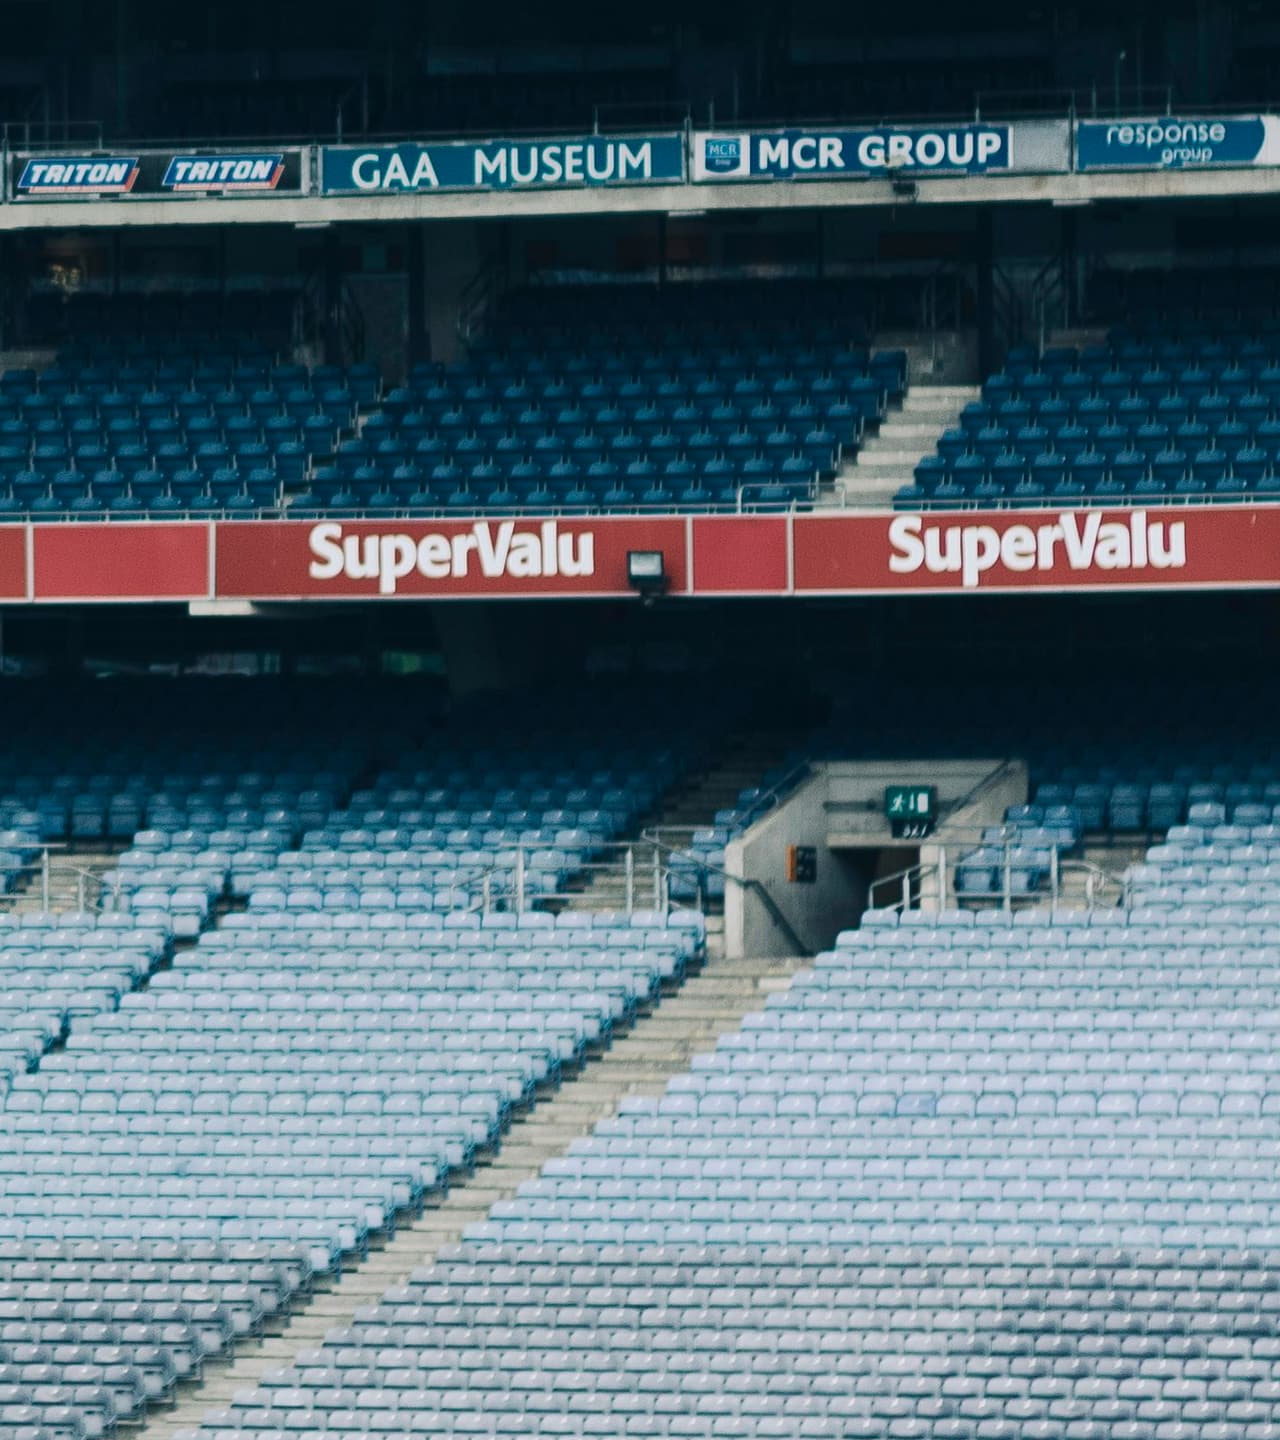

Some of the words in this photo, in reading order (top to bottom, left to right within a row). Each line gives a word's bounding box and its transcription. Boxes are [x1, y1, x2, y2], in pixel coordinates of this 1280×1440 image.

[709, 143, 737, 156] MCR
[1107, 123, 1226, 150] response
[759, 138, 845, 169] MCR
[858, 132, 1002, 167] GROUP
[1161, 146, 1213, 164] group
[30, 163, 129, 184] TRITON
[175, 160, 273, 181] TRITON
[351, 152, 439, 189] GAA
[474, 142, 651, 184] MUSEUM
[308, 521, 594, 594] SuperValu
[888, 510, 1187, 587] SuperValu
